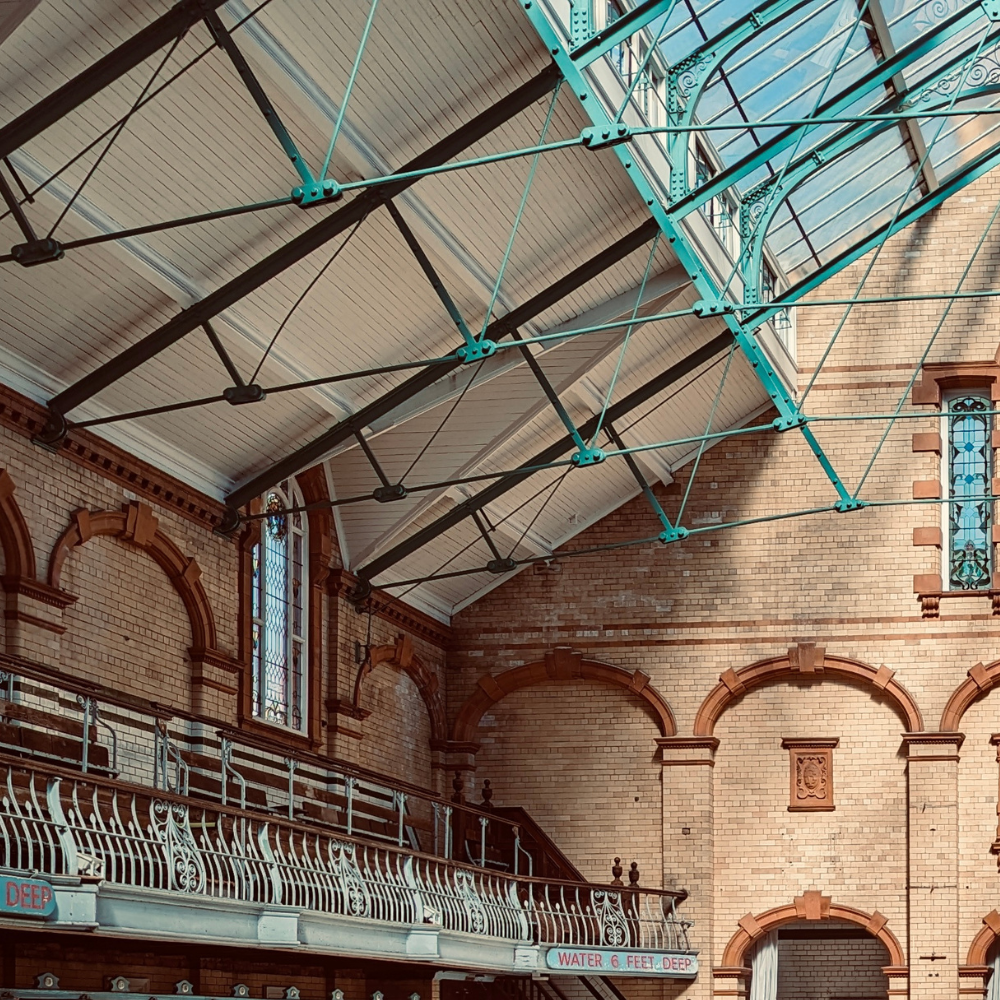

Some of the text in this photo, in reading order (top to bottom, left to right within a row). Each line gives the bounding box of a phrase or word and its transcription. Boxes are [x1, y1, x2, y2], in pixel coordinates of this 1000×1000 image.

[6, 881, 52, 910] DEEP
[558, 952, 691, 971] WATER 6 FEET DEEP
